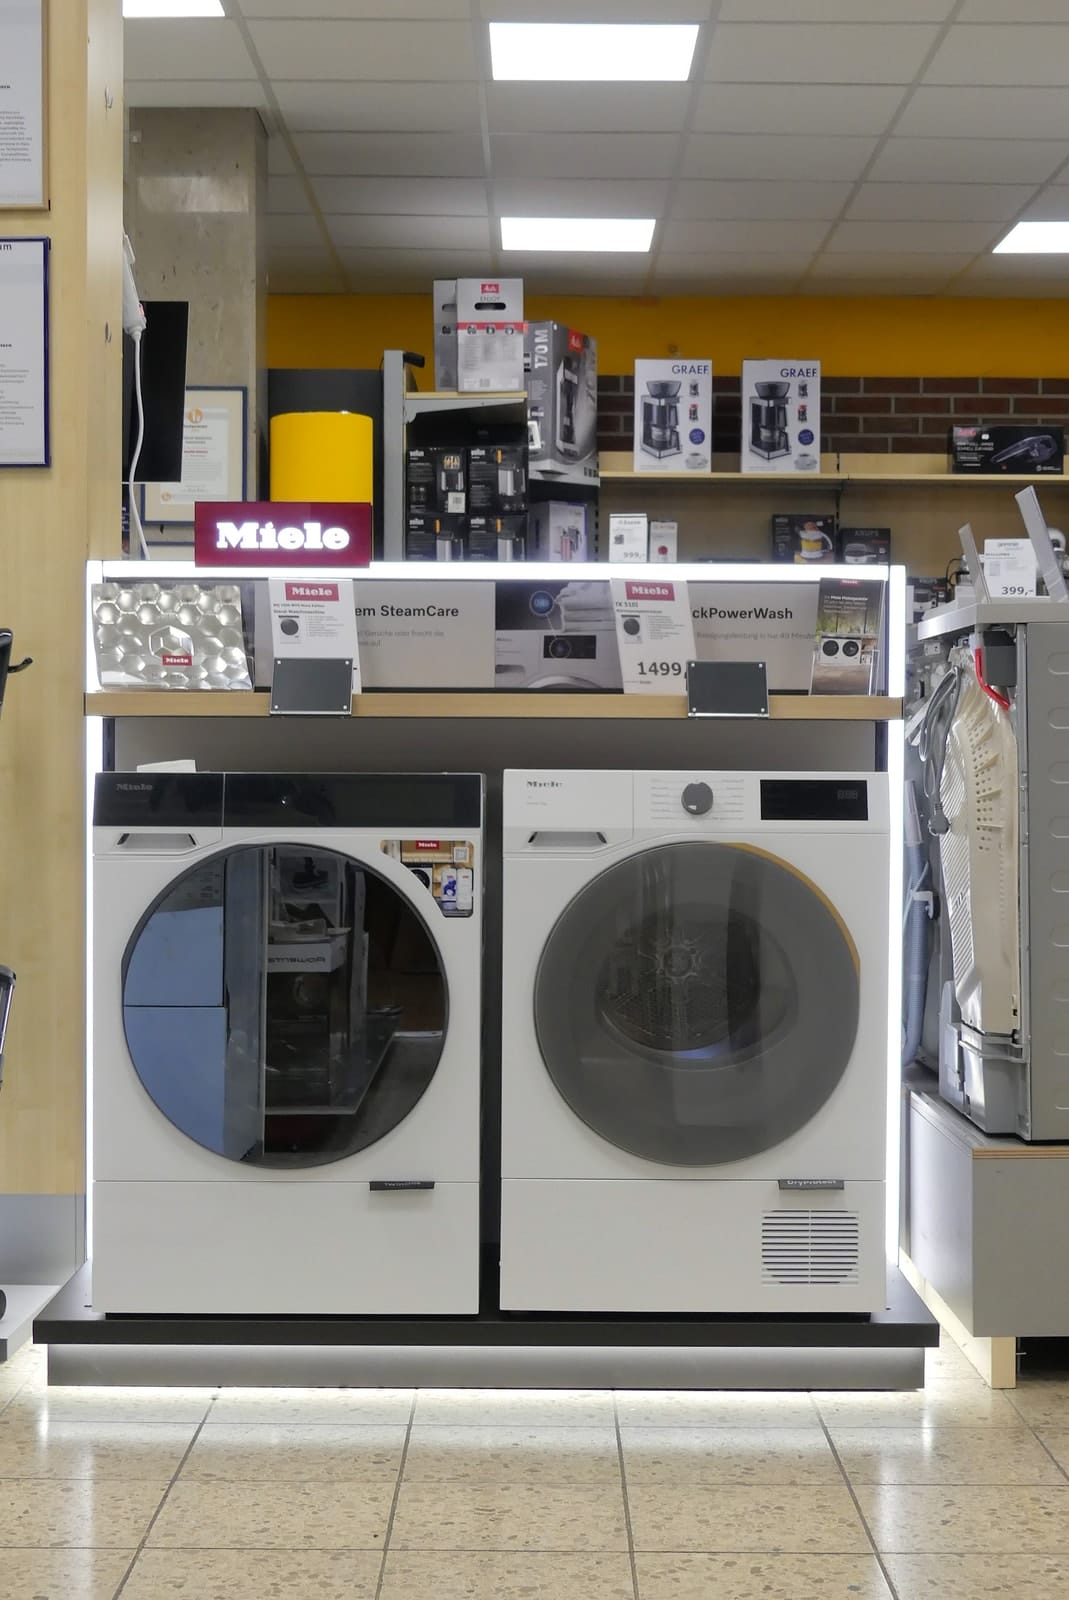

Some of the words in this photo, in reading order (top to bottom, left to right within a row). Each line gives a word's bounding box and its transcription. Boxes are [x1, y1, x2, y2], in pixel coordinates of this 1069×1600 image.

[672, 364, 709, 375] GRAEF
[780, 368, 817, 378] GRAEF
[216, 521, 350, 550] Miele
[291, 586, 333, 597] Miele
[631, 586, 669, 596] Miele
[1001, 586, 1034, 596] 399,-
[380, 605, 460, 617] SteamCare
[165, 656, 189, 664] Miele
[116, 783, 153, 791] Miele
[526, 780, 563, 789] Miele
